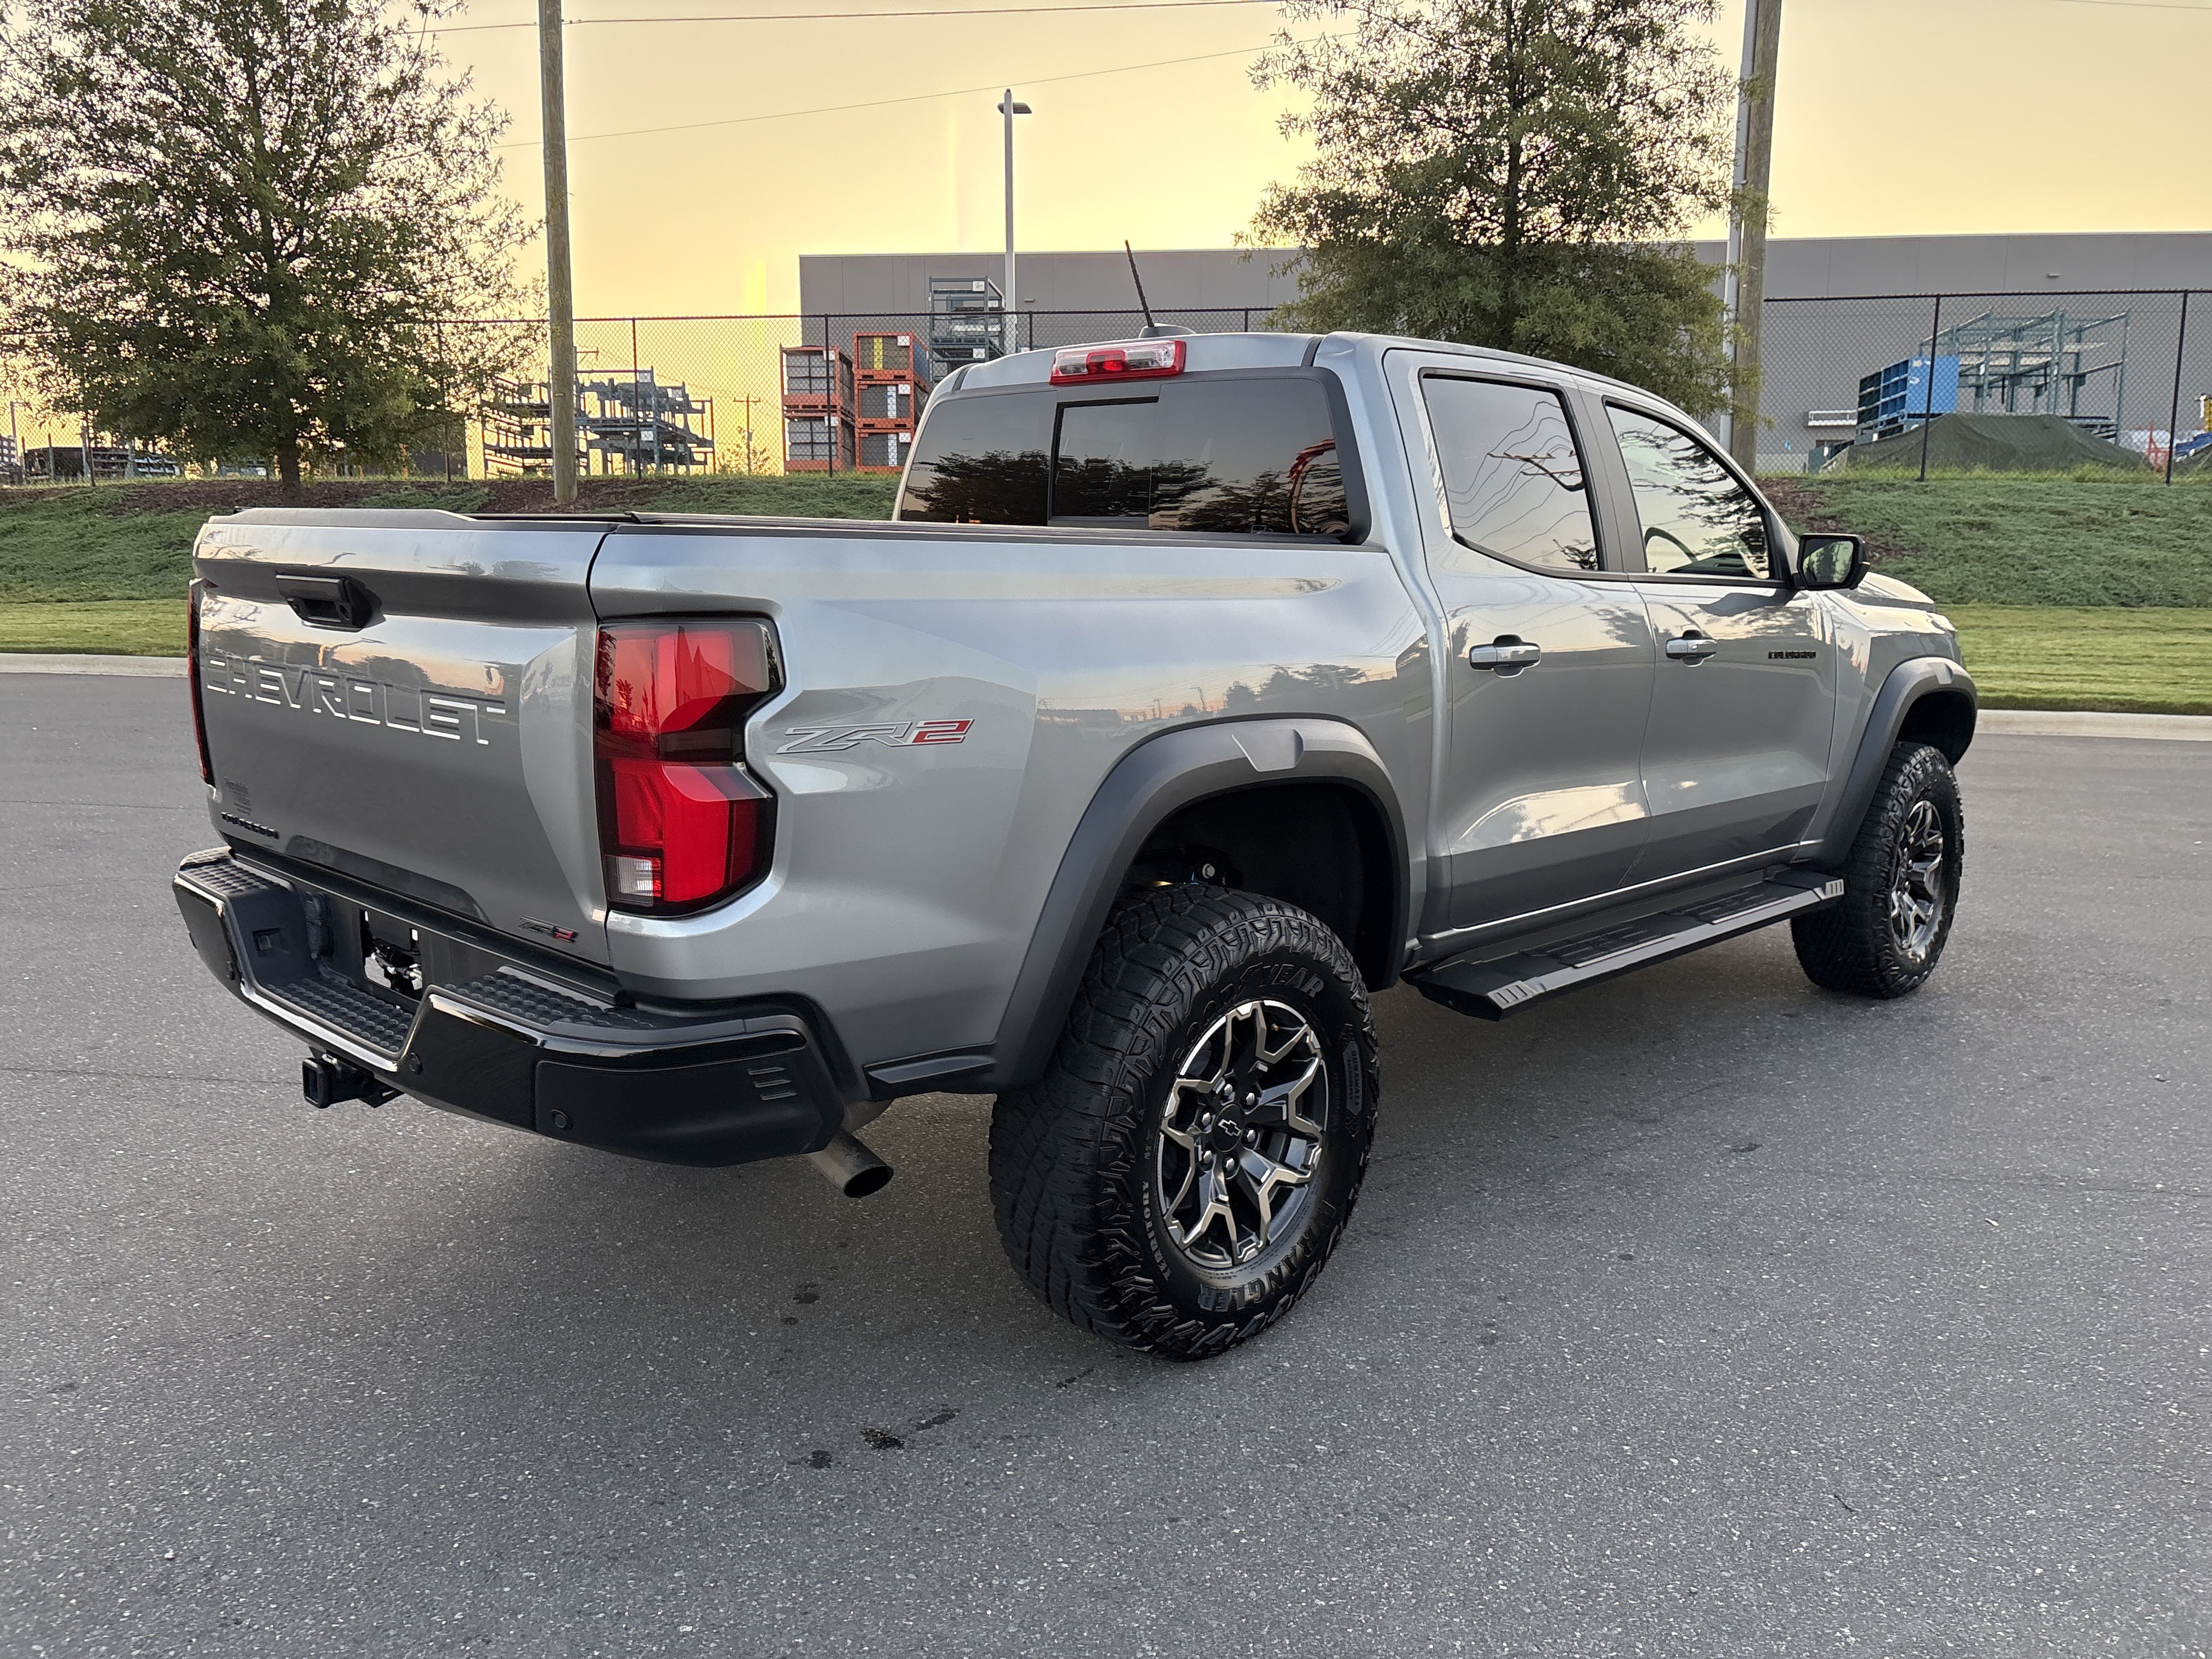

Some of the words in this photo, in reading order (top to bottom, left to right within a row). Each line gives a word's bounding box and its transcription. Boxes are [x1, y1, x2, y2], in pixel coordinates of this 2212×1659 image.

[206, 652, 506, 744] CHEVROLET
[775, 718, 975, 755] ZR2
[1142, 1180, 1172, 1282] TERRITORY
[1198, 1199, 1338, 1313] WRANGLER
